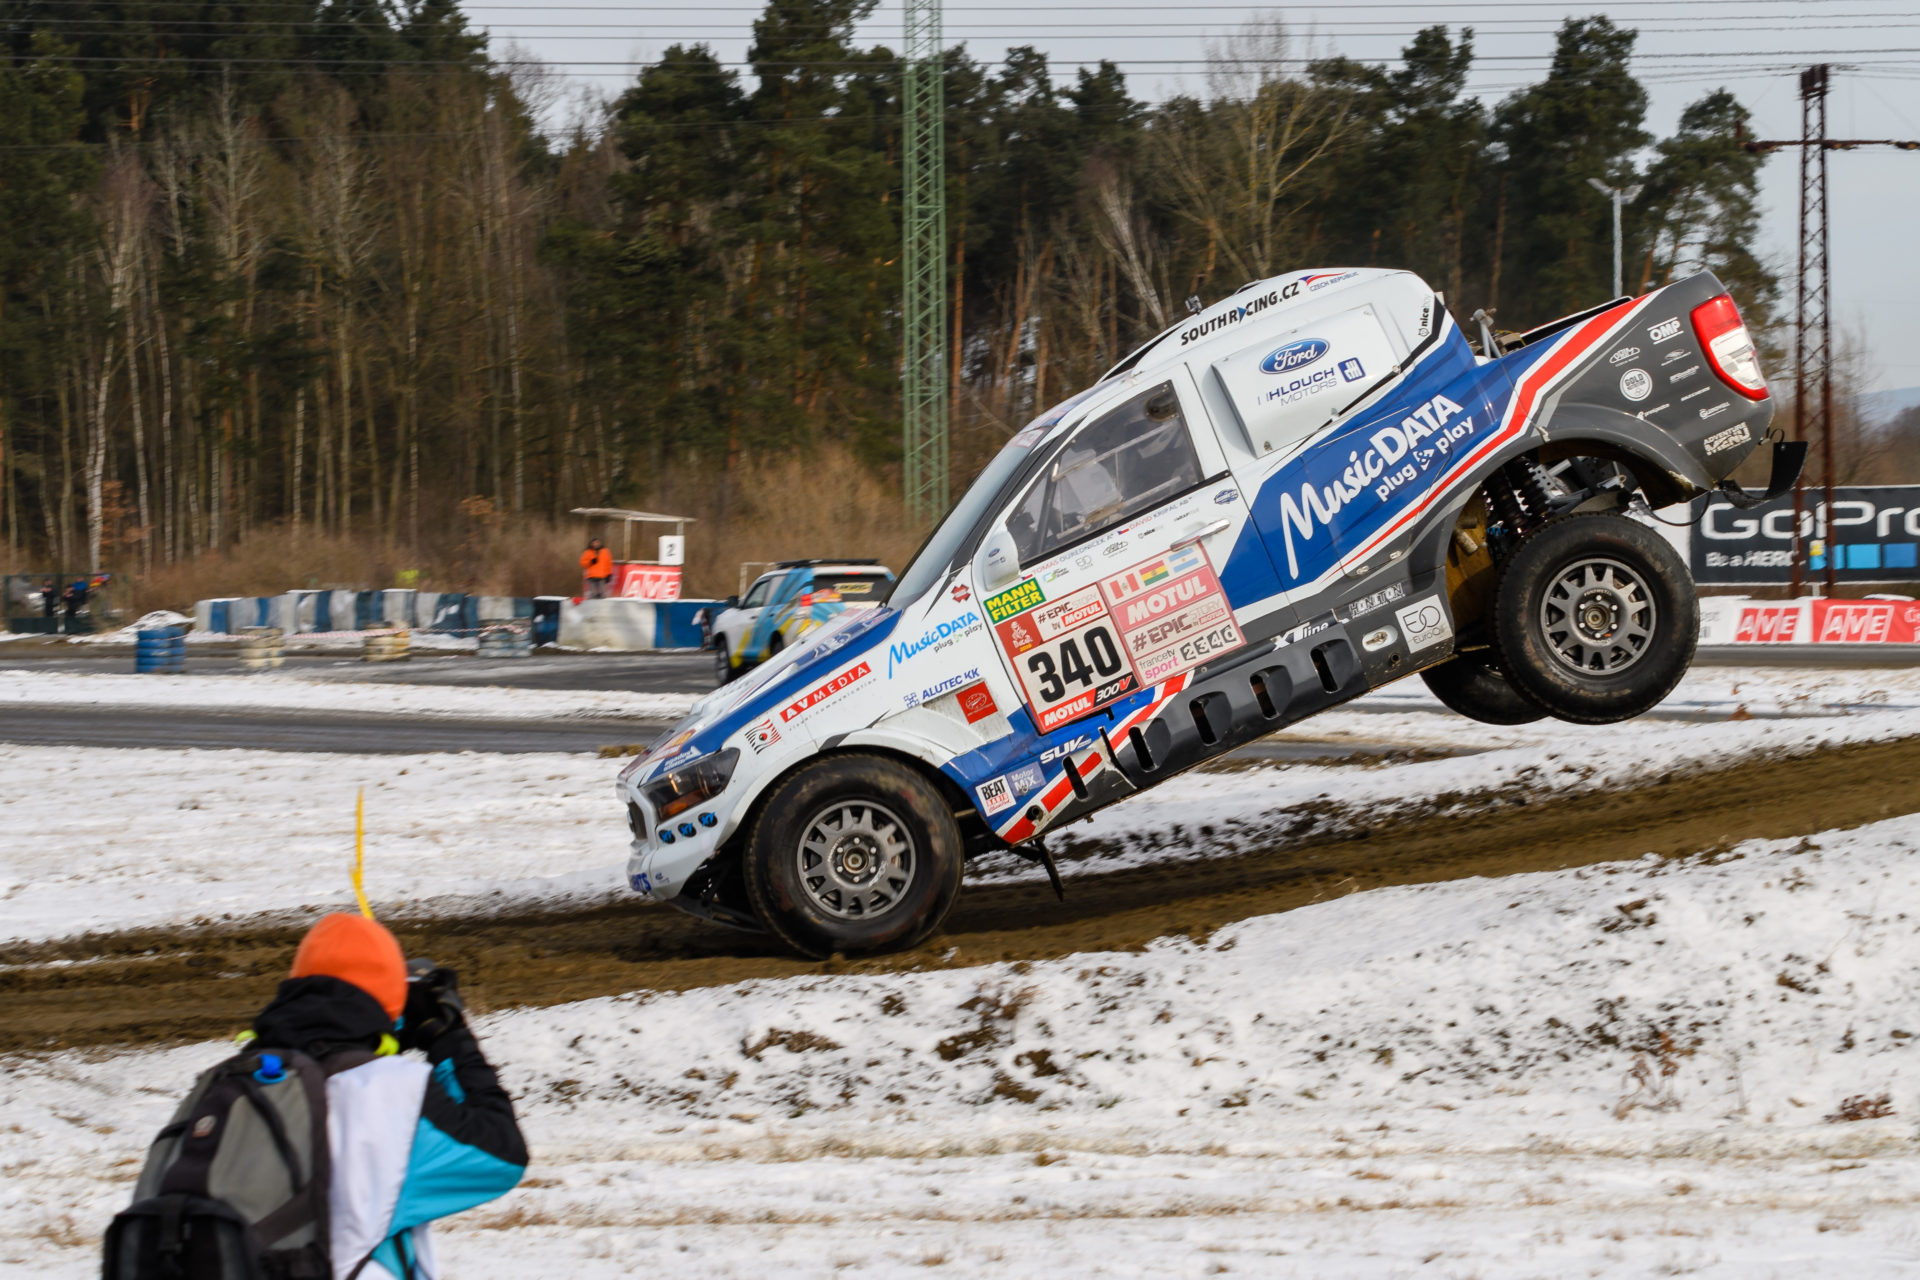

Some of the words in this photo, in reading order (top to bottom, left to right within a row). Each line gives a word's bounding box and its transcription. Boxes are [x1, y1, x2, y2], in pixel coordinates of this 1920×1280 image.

[1650, 319, 1681, 341] OMP
[1273, 344, 1319, 371] Ford
[1269, 367, 1335, 401] HLOUCH
[1280, 377, 1338, 407] MOTORS
[1624, 373, 1644, 387] GOLD
[1375, 462, 1415, 502] plug
[1435, 415, 1475, 455] play
[665, 543, 677, 557] 2
[1705, 551, 1729, 567] Be
[1729, 555, 1744, 567] a
[987, 580, 1038, 612] MANN
[990, 589, 1044, 622] FILTER
[1127, 576, 1208, 626] MOTUL
[1064, 603, 1101, 625] MOTUL
[933, 639, 954, 653] plug
[964, 622, 983, 637] play
[1027, 626, 1123, 703] 340
[1139, 648, 1175, 670] francetv
[1144, 655, 1179, 680] sport
[922, 675, 963, 700] ALUTEC
[964, 667, 980, 680] KK
[1043, 693, 1092, 727] MOTUL
[1095, 675, 1133, 702] 300V
[1011, 768, 1034, 780] Motor
[1014, 774, 1038, 793] MIX
[980, 778, 1007, 801] BEAT
